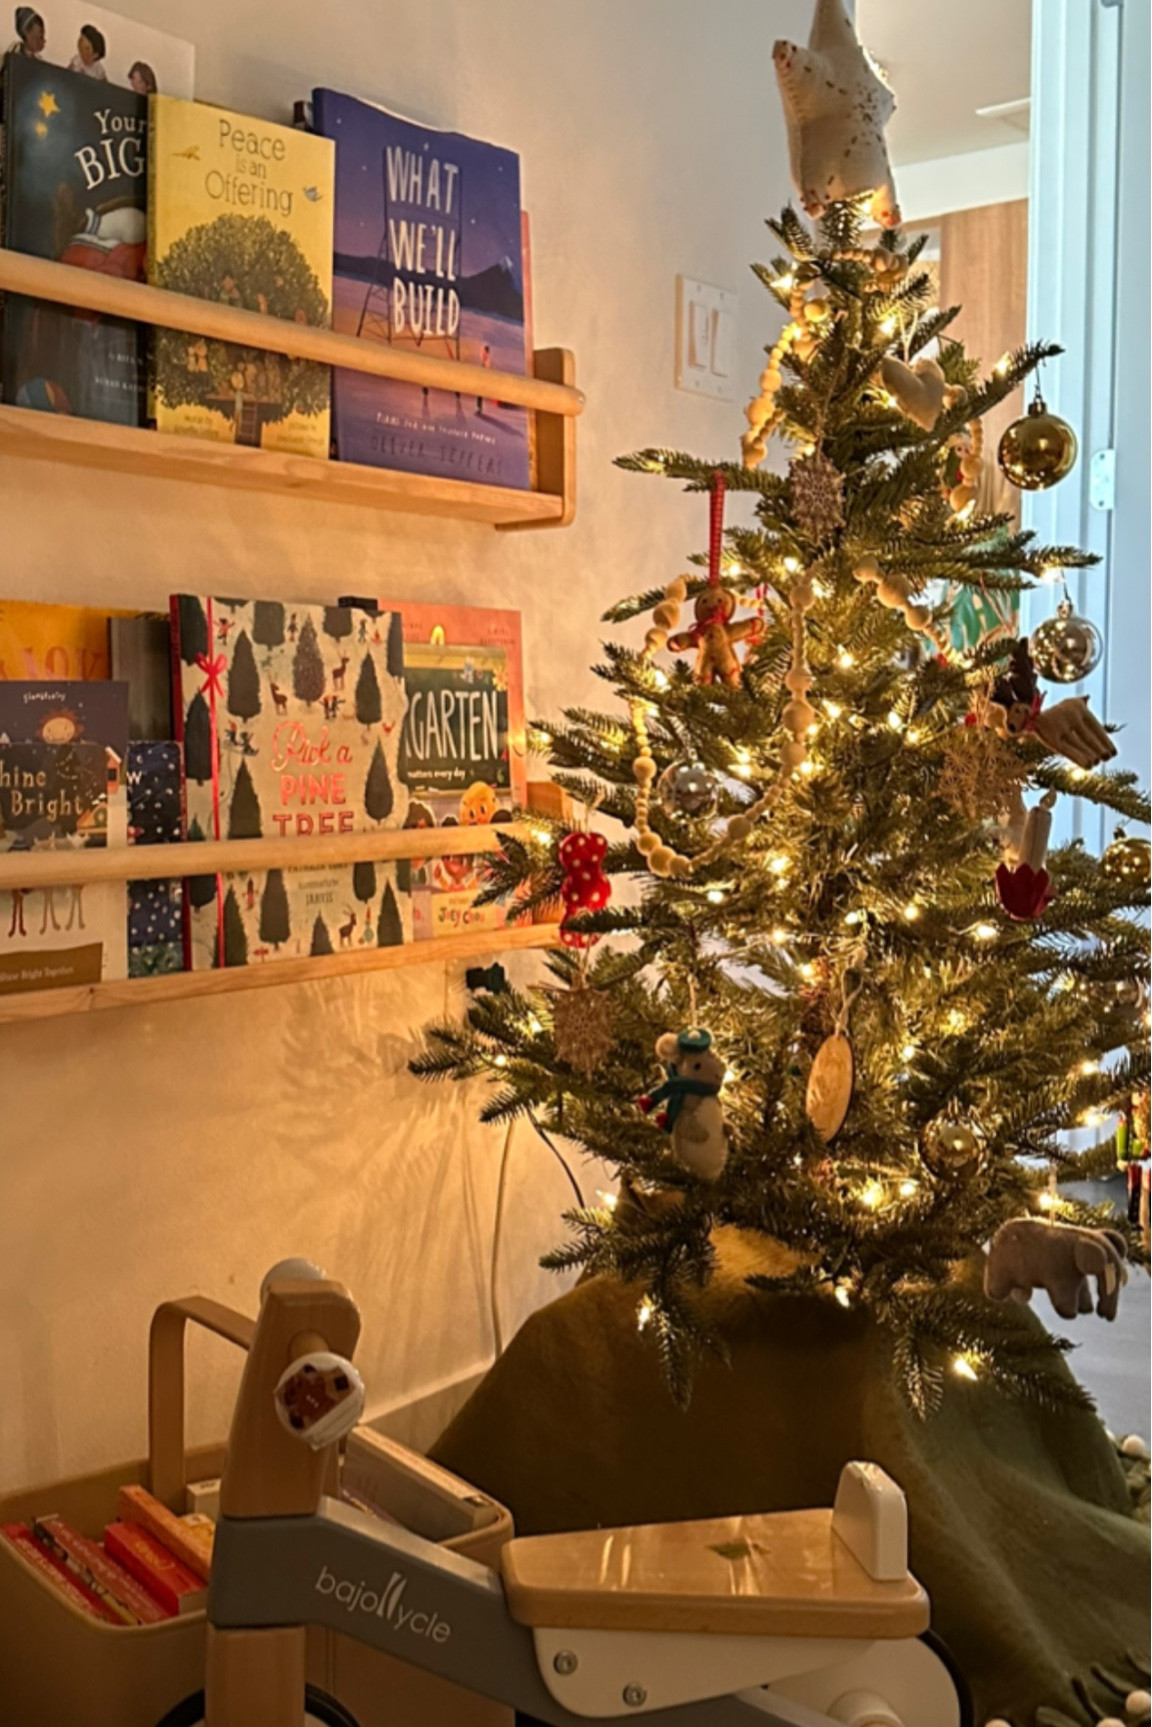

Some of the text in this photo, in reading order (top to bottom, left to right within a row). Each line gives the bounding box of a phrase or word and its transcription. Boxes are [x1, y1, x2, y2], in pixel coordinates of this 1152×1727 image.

[94, 109, 147, 135] Your
[218, 119, 287, 162] Peace
[75, 136, 146, 190] BIG
[235, 153, 268, 179] is an
[385, 146, 459, 214] WHAT
[204, 169, 294, 218] Offering
[388, 218, 456, 281] WE'LL
[393, 276, 460, 336] BUILD
[271, 721, 353, 772] Pick a
[404, 689, 498, 761] GARTEN
[280, 773, 347, 807] PINE
[453, 766, 466, 780] day
[11, 790, 84, 822] Bright
[272, 811, 355, 837] TREE
[315, 1565, 451, 1643] bajollycle
